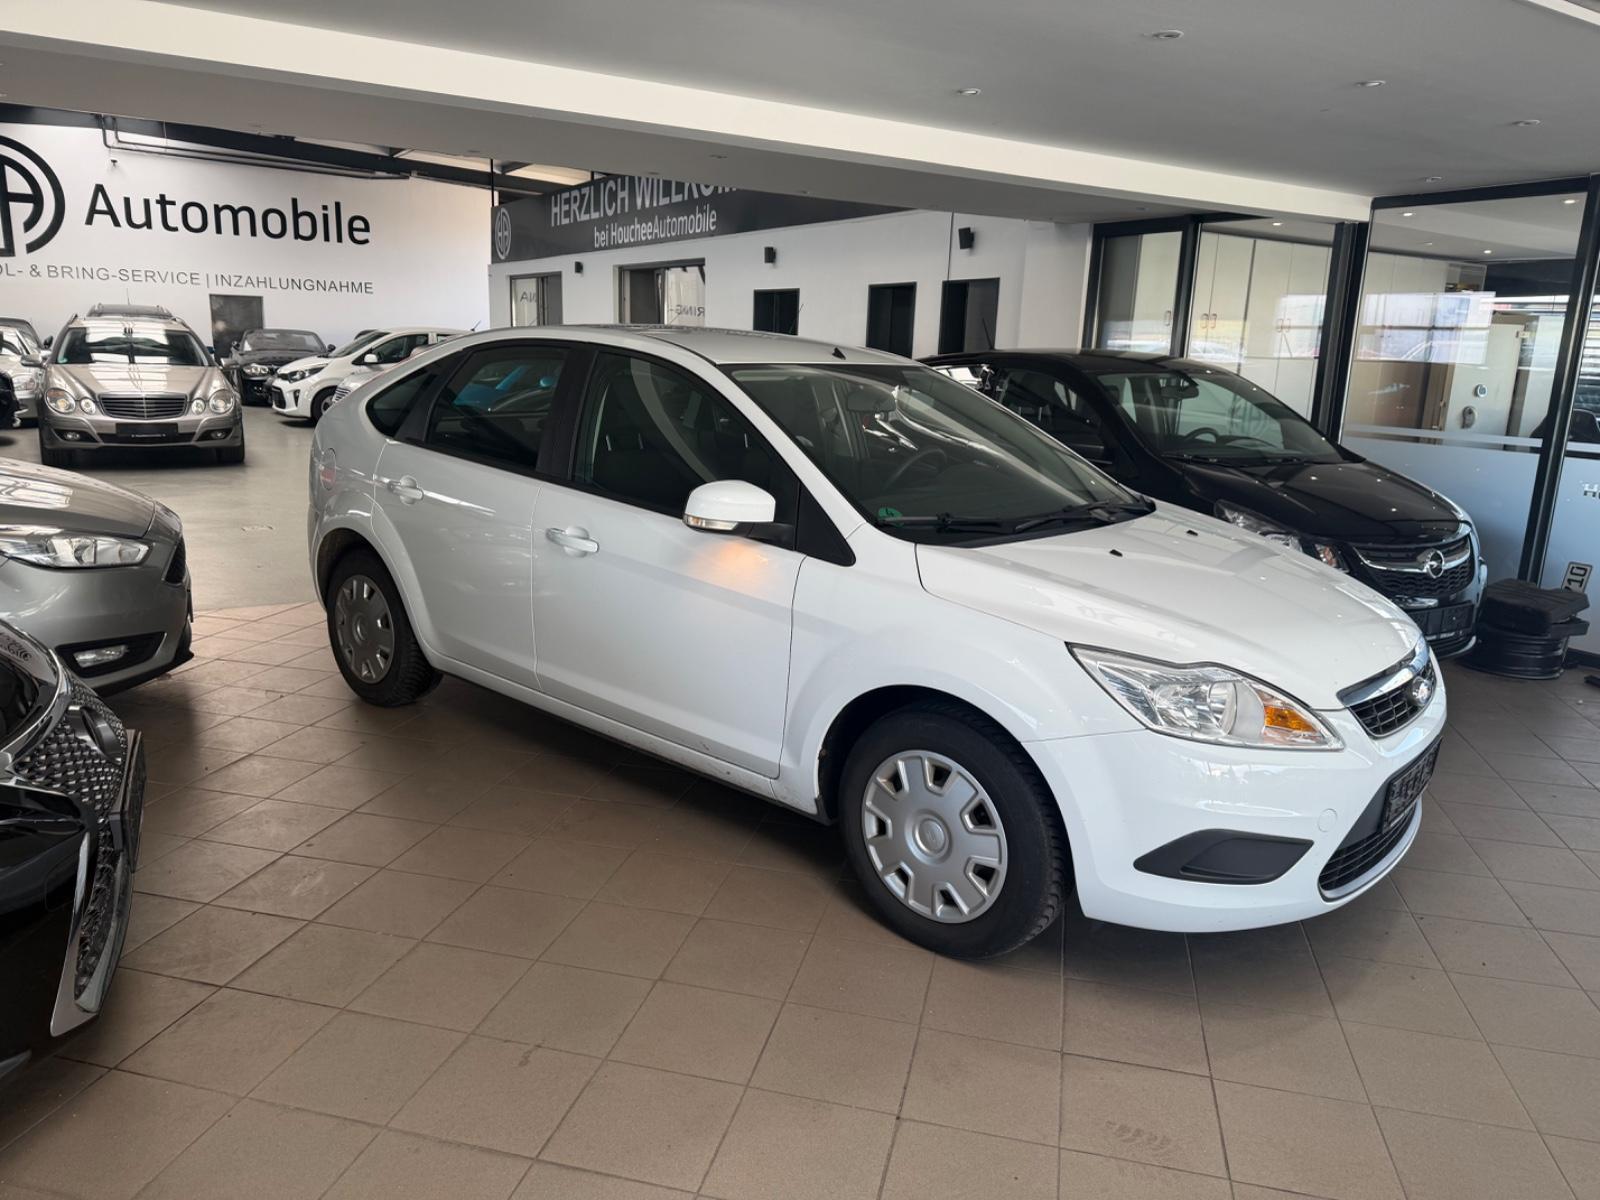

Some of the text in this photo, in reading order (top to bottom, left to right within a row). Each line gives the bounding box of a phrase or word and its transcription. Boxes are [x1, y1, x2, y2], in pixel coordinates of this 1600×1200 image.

[85, 183, 371, 245] Automobile
[551, 177, 629, 227] HERZLICH
[594, 204, 717, 249] bei HoucheeAutomobile
[0, 263, 23, 277] L-
[30, 264, 42, 278] &
[47, 265, 200, 286] BRING-SERVICE
[215, 273, 374, 294] INZAHLUNGNAHME
[1583, 483, 1600, 499] H
